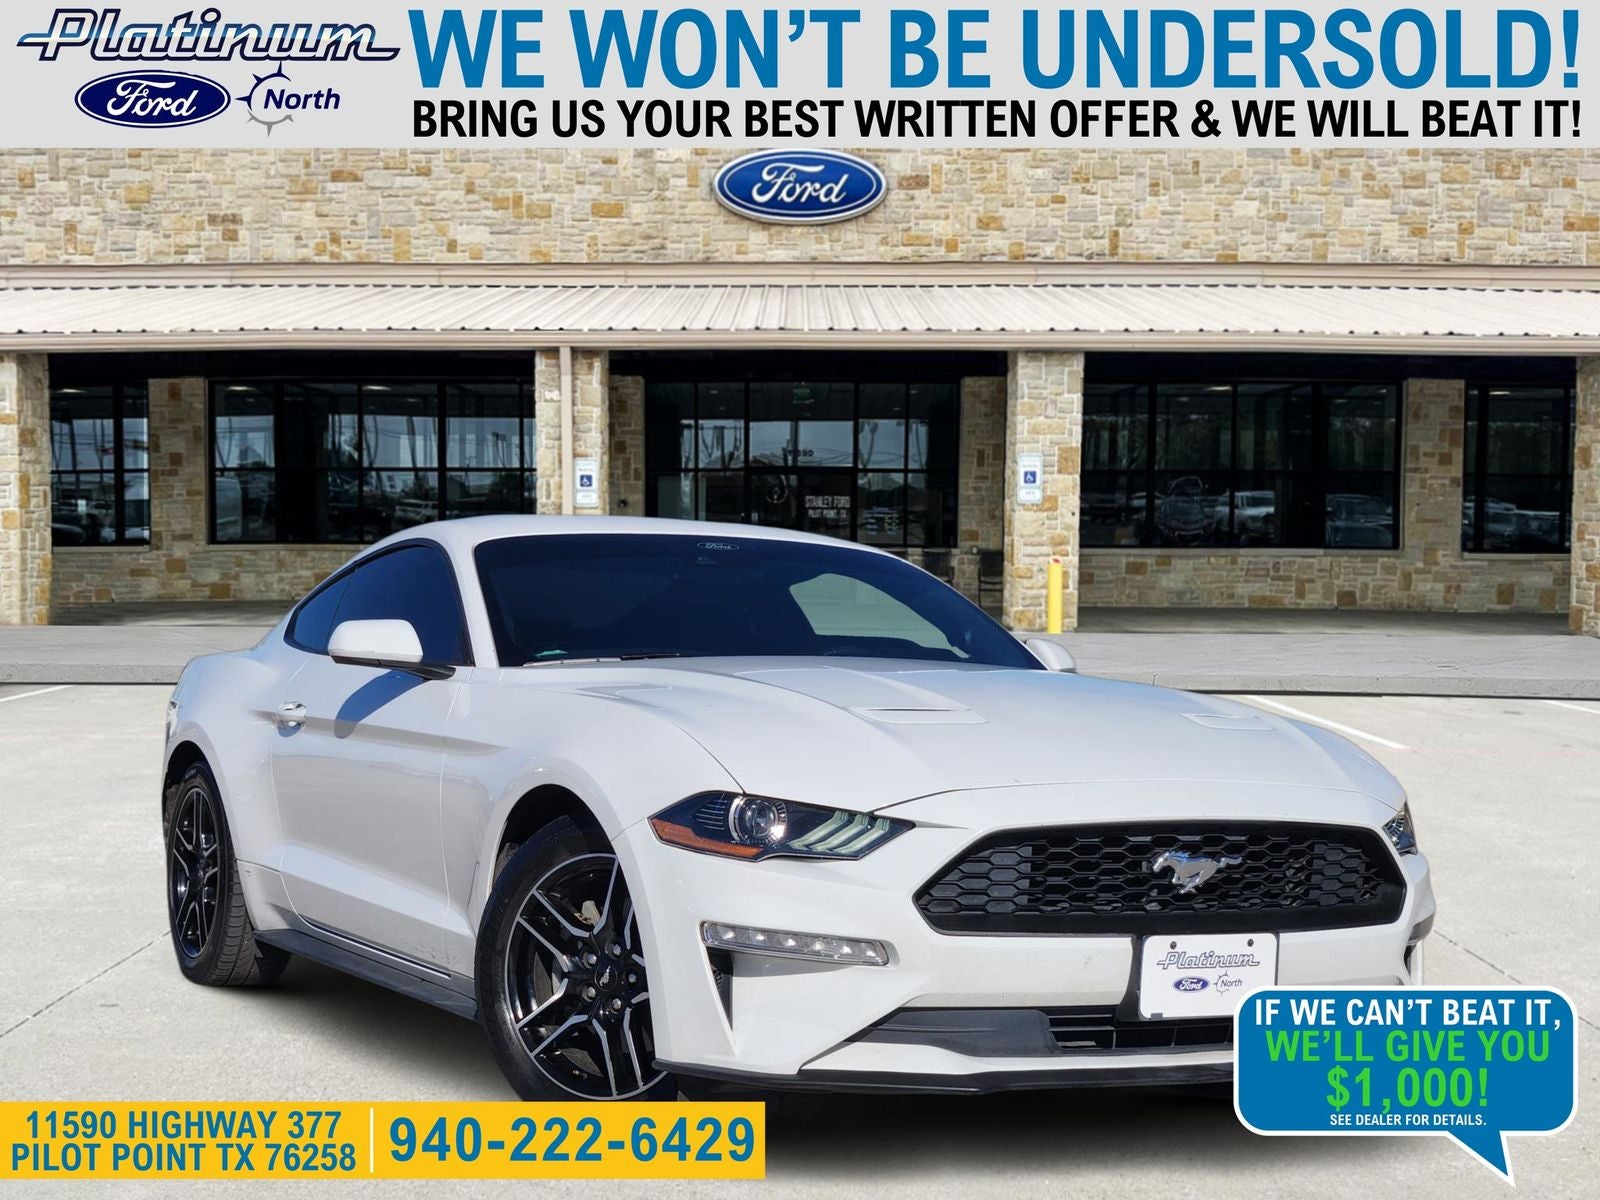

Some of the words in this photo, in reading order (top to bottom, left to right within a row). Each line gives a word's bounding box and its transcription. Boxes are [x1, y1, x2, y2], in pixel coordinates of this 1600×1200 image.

[752, 162, 849, 203] Ford
[1156, 951, 1260, 970] Platinum
[1220, 978, 1243, 988] North
